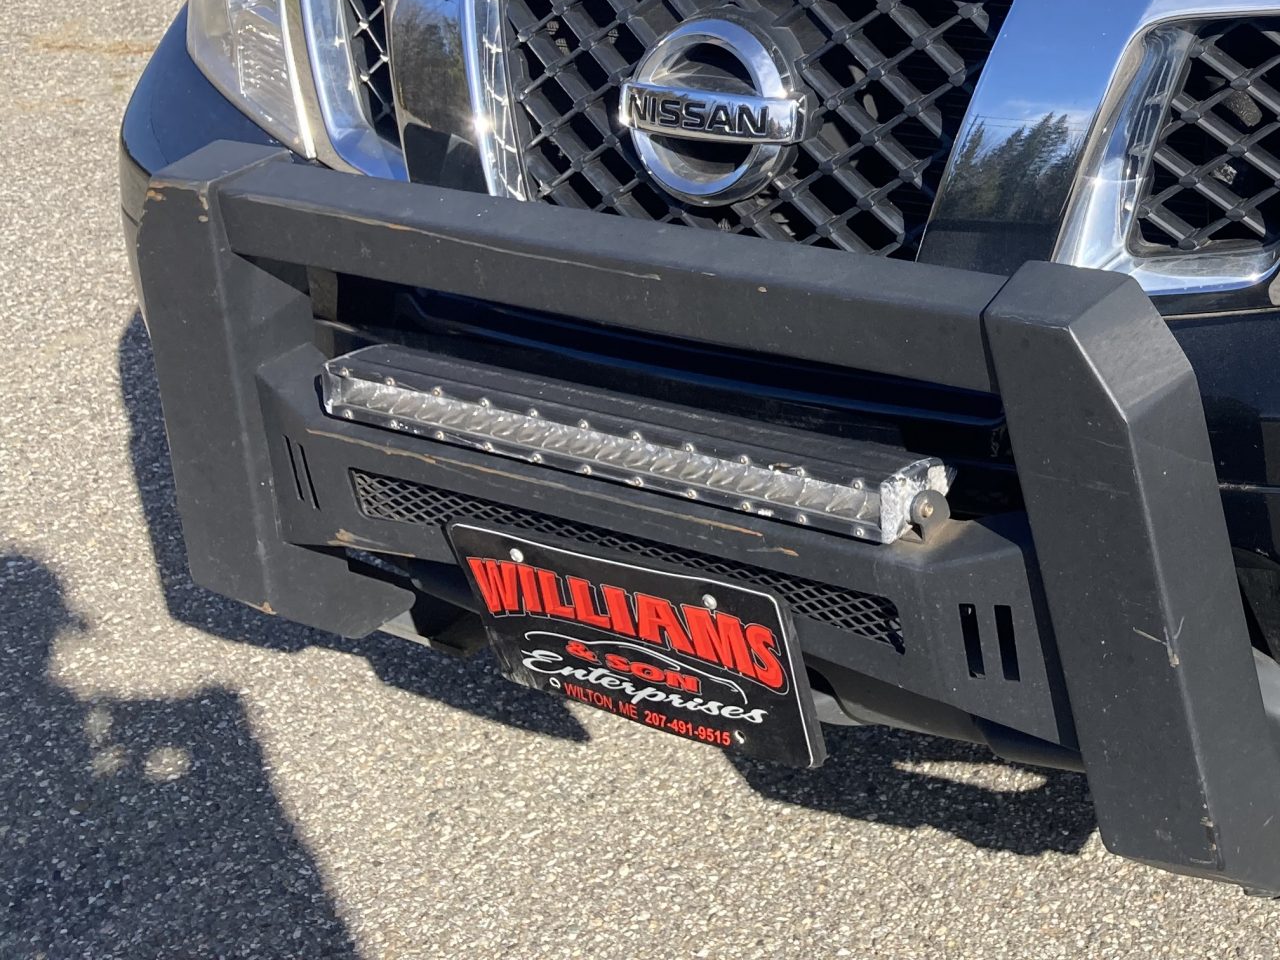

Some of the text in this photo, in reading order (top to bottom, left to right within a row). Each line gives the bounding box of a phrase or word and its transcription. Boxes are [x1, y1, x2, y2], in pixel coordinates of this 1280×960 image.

[629, 93, 770, 136] NISSAN
[466, 556, 788, 694] WILLIAMS
[521, 648, 769, 724] Enterprises
[565, 640, 702, 695] & SON
[563, 682, 732, 747] WILTON, ME 207-491-9515
